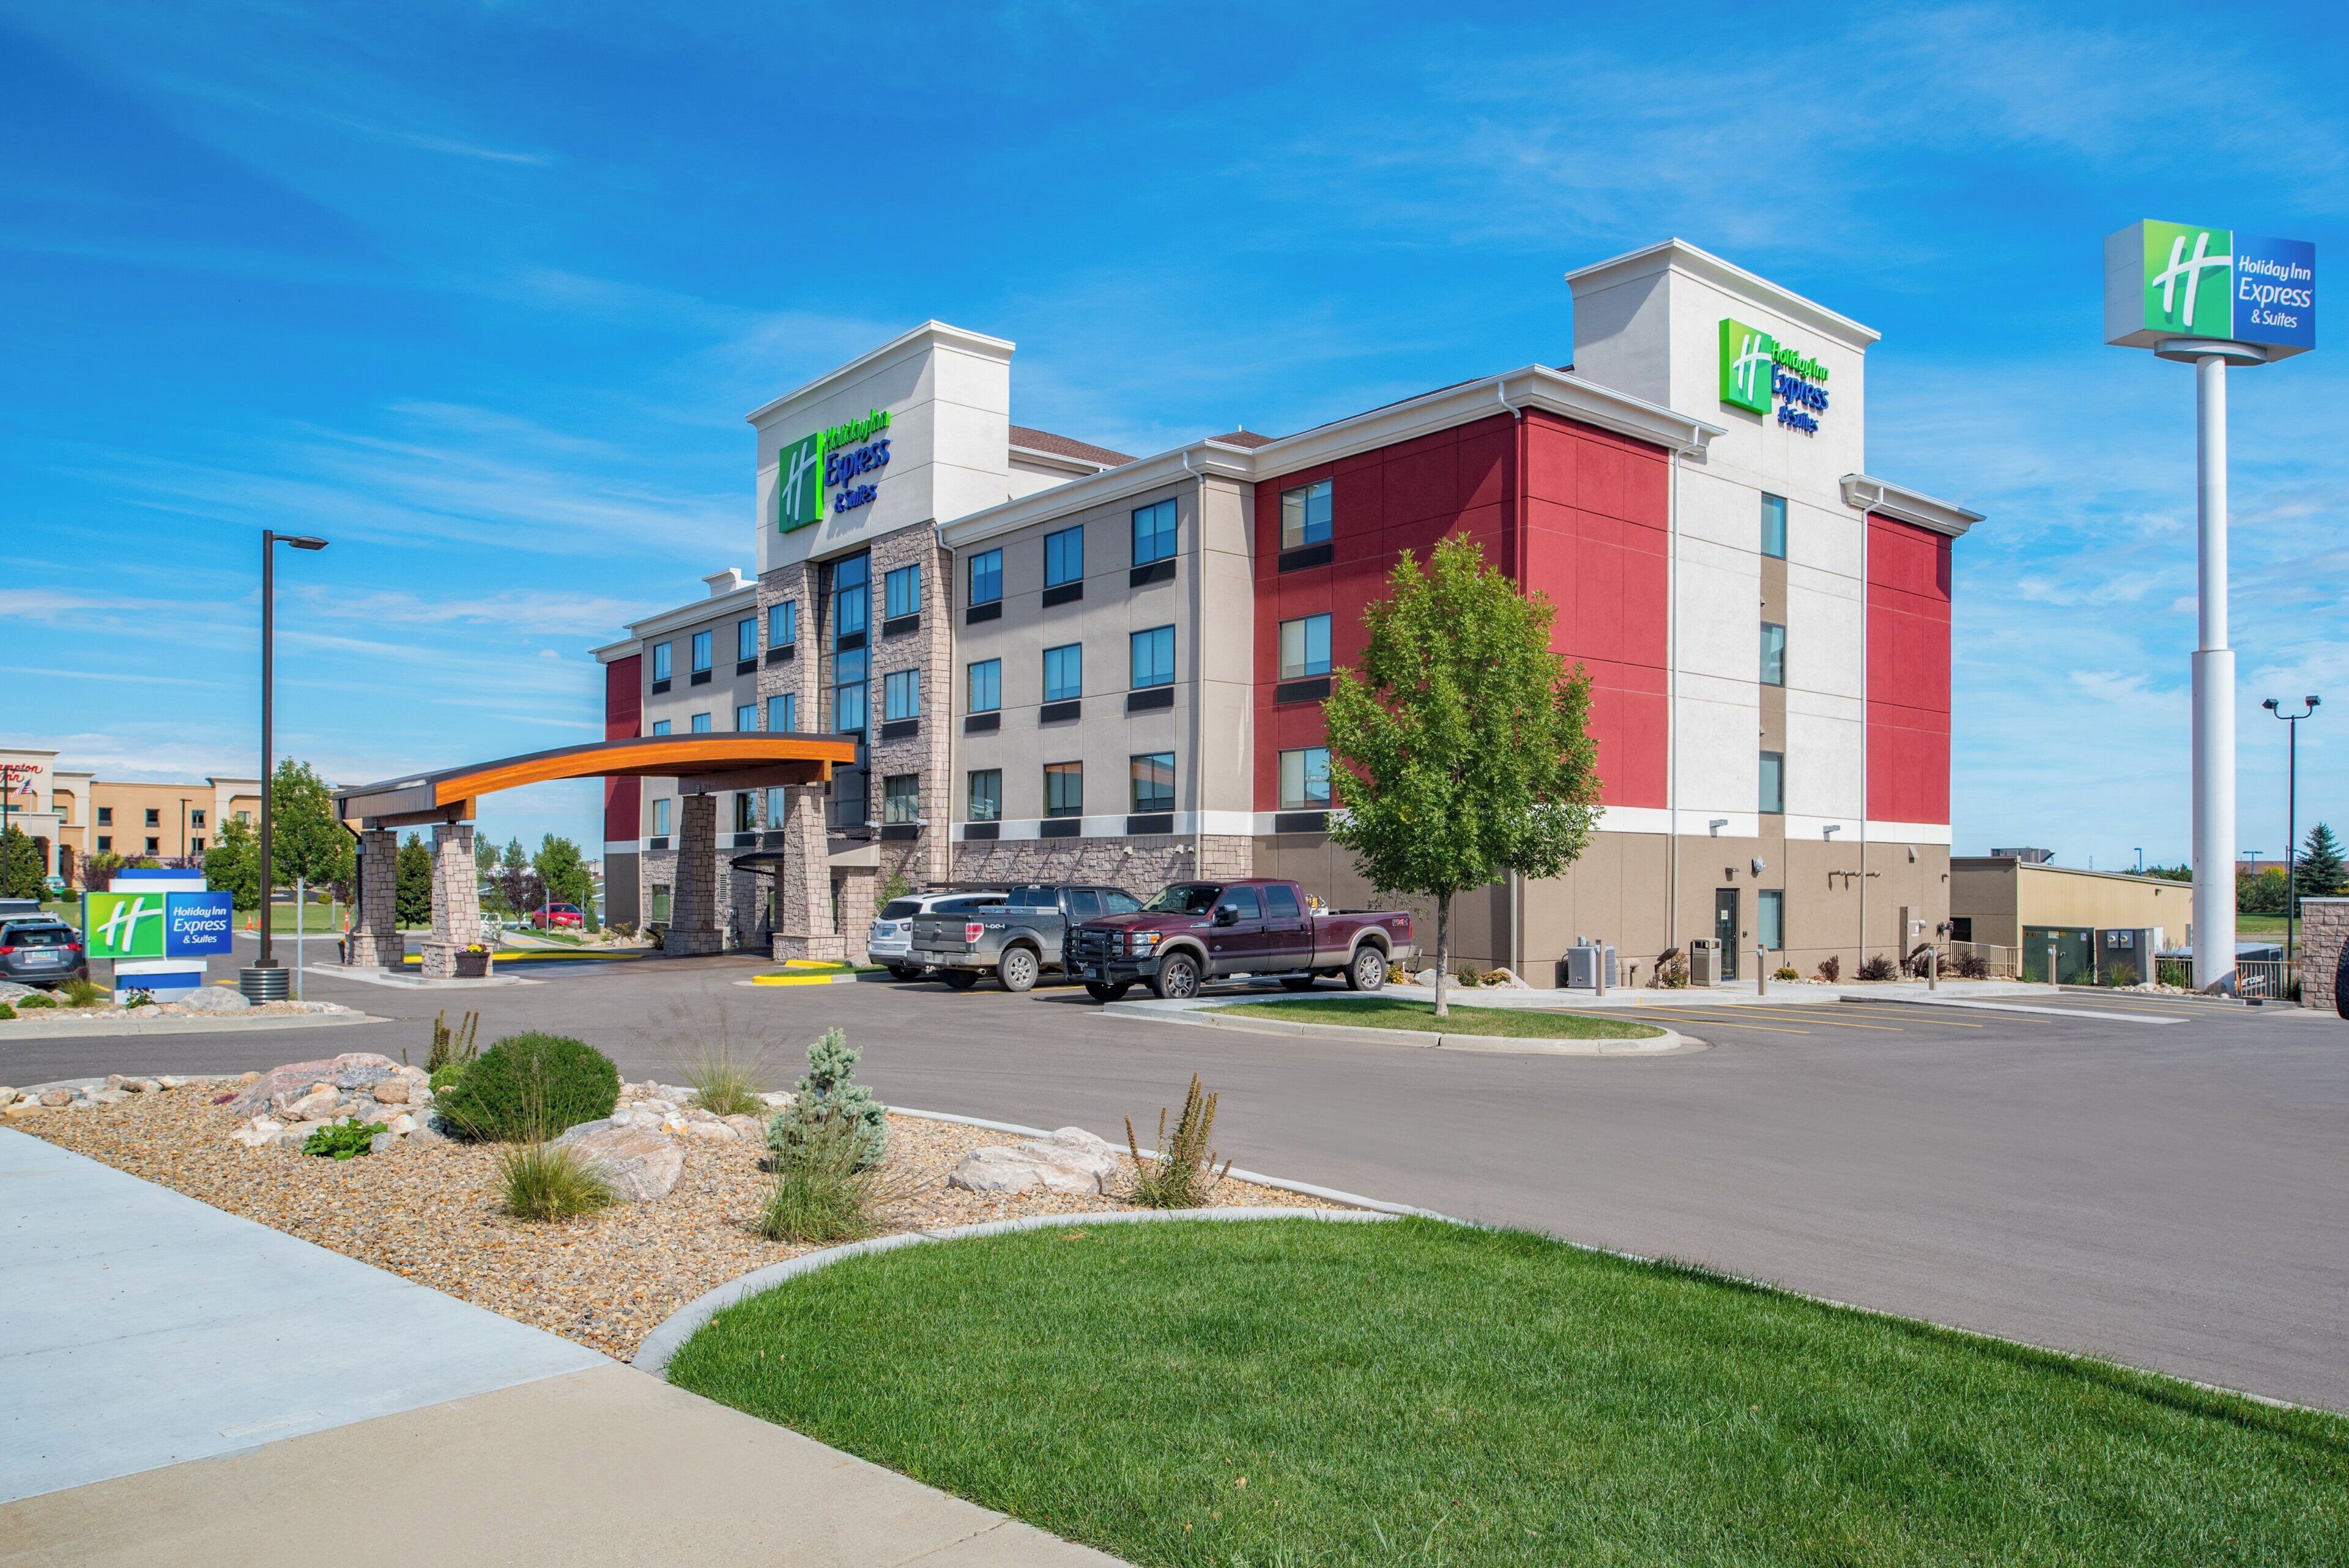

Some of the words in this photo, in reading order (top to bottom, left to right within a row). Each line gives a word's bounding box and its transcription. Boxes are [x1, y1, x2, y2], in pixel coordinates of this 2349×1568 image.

[2238, 255, 2290, 282] Holiday
[2290, 262, 2311, 281] Inn
[2238, 277, 2311, 308] Express
[2251, 309, 2262, 324] &
[2262, 310, 2298, 328] Suites
[1771, 340, 1813, 378] Holiday
[1810, 357, 1829, 382] Inn
[1771, 363, 1829, 411] Express
[824, 418, 870, 453] Holiday
[869, 409, 891, 434] Inn
[1778, 404, 1789, 423] &
[1787, 408, 1819, 433] Suites
[824, 439, 891, 489] Express
[834, 492, 845, 513] &
[844, 484, 878, 510] Suites
[173, 906, 212, 918] Holiday
[211, 905, 226, 916] Inn
[173, 918, 227, 935] Express
[182, 935, 191, 944] &
[191, 934, 218, 944] Suites
